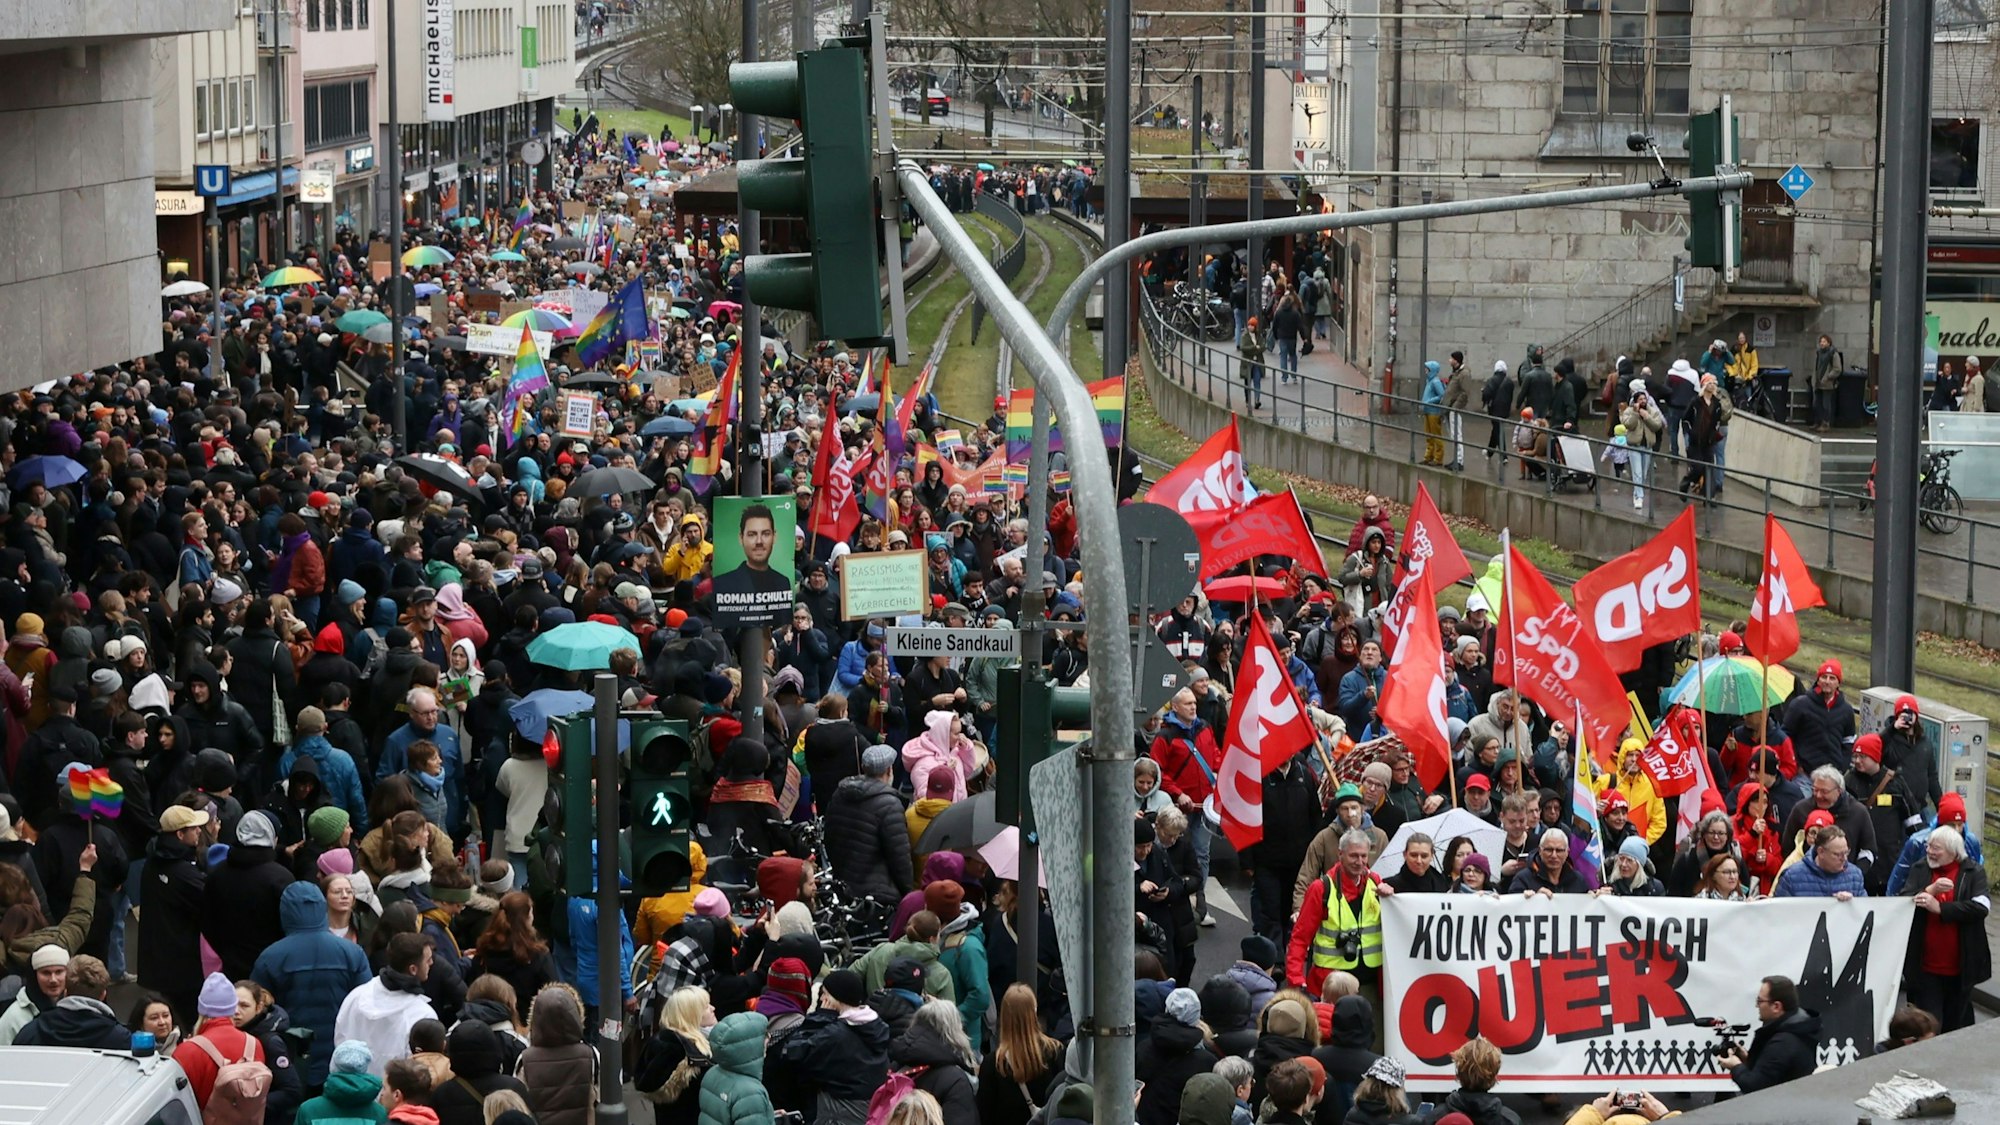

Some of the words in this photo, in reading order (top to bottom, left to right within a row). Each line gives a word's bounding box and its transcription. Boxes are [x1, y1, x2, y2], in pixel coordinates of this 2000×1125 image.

[1295, 86, 1328, 99] BALLETT
[1294, 140, 1327, 150] JAZZ
[201, 169, 225, 192] U
[851, 563, 904, 577] RASSISMUS
[716, 593, 754, 604] ROMAN
[755, 590, 793, 603] SCHULTE
[854, 597, 916, 611] VERBRECHEN
[897, 632, 942, 651] Kleine
[946, 633, 1014, 652] Sandkaul
[1515, 616, 1580, 681] SPD
[1409, 902, 1489, 963] KÖLN
[1496, 913, 1606, 963] STELLT
[1618, 914, 1709, 963] SICH
[1399, 939, 1693, 1066] QUER
